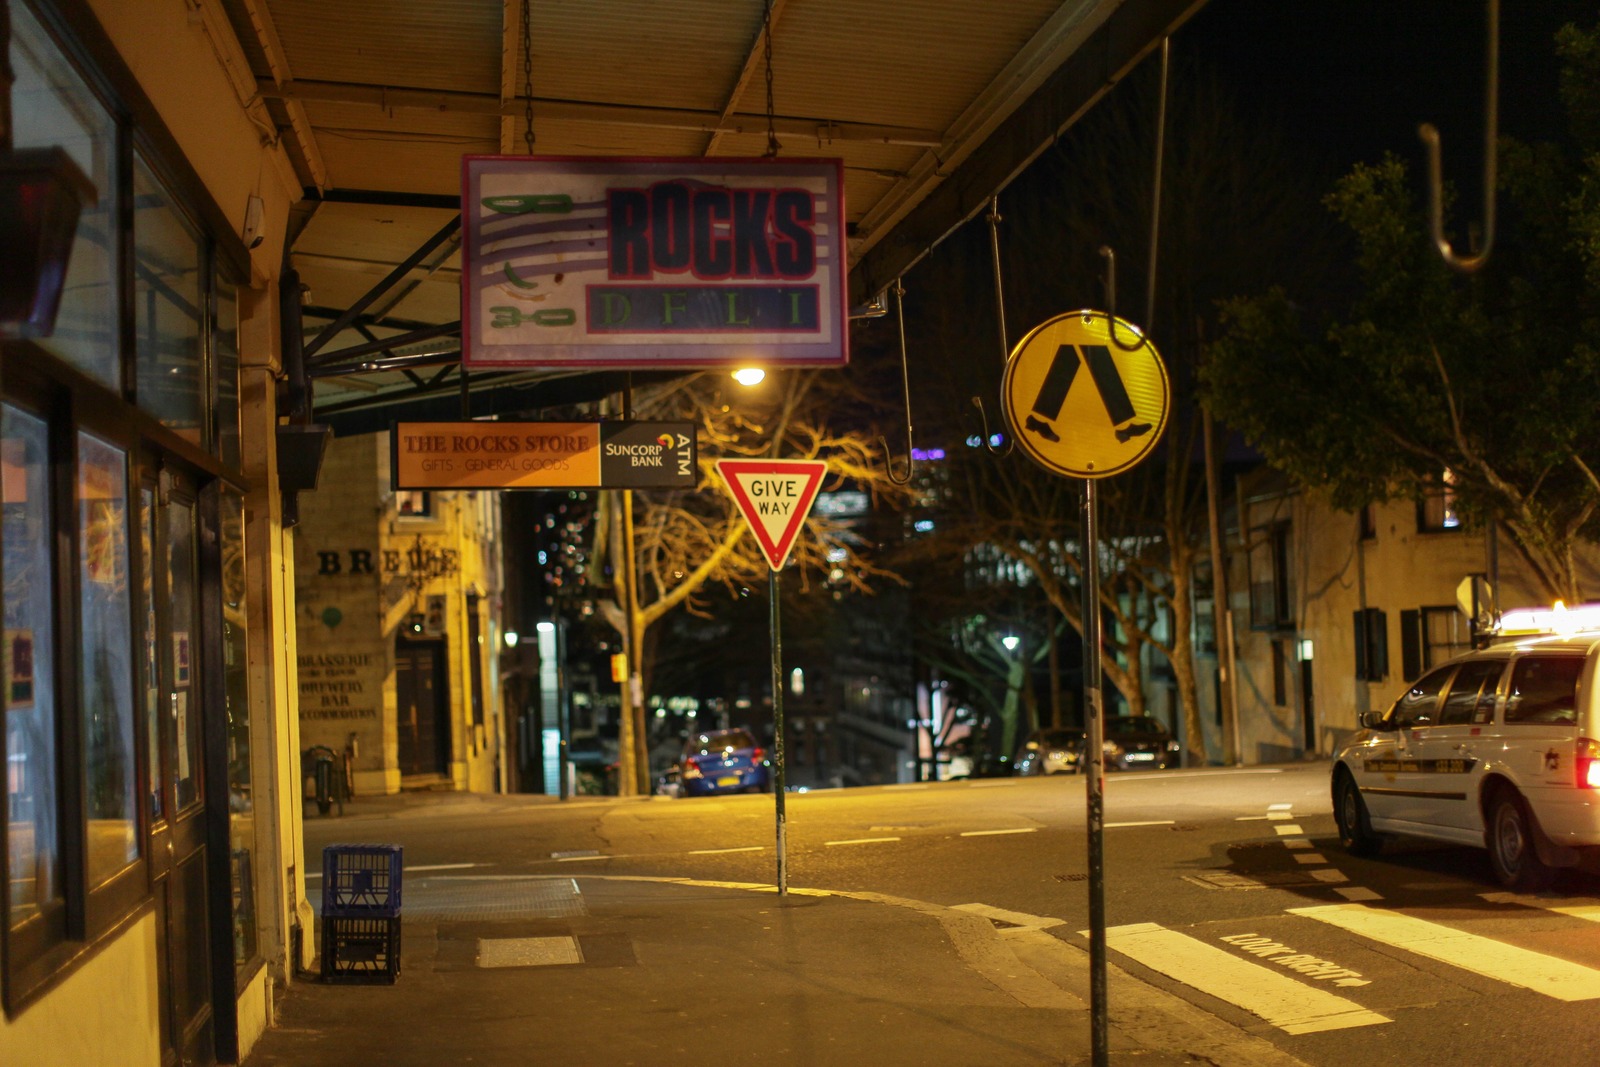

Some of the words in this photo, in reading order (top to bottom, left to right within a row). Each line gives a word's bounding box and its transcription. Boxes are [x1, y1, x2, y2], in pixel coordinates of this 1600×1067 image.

[606, 180, 818, 281] ROCKS
[404, 435, 447, 452] THE
[452, 434, 520, 452] ROCKS
[525, 434, 590, 452] STORE
[631, 456, 663, 467] BANK
[677, 433, 691, 475] ATM
[421, 458, 453, 472] GIFTS
[464, 458, 519, 471] GENERAL
[522, 458, 570, 471] GOODS
[751, 480, 797, 497] GIVE
[759, 502, 790, 515] WAY
[1218, 933, 1297, 958] LOOK
[1267, 954, 1363, 980] RIGHT
